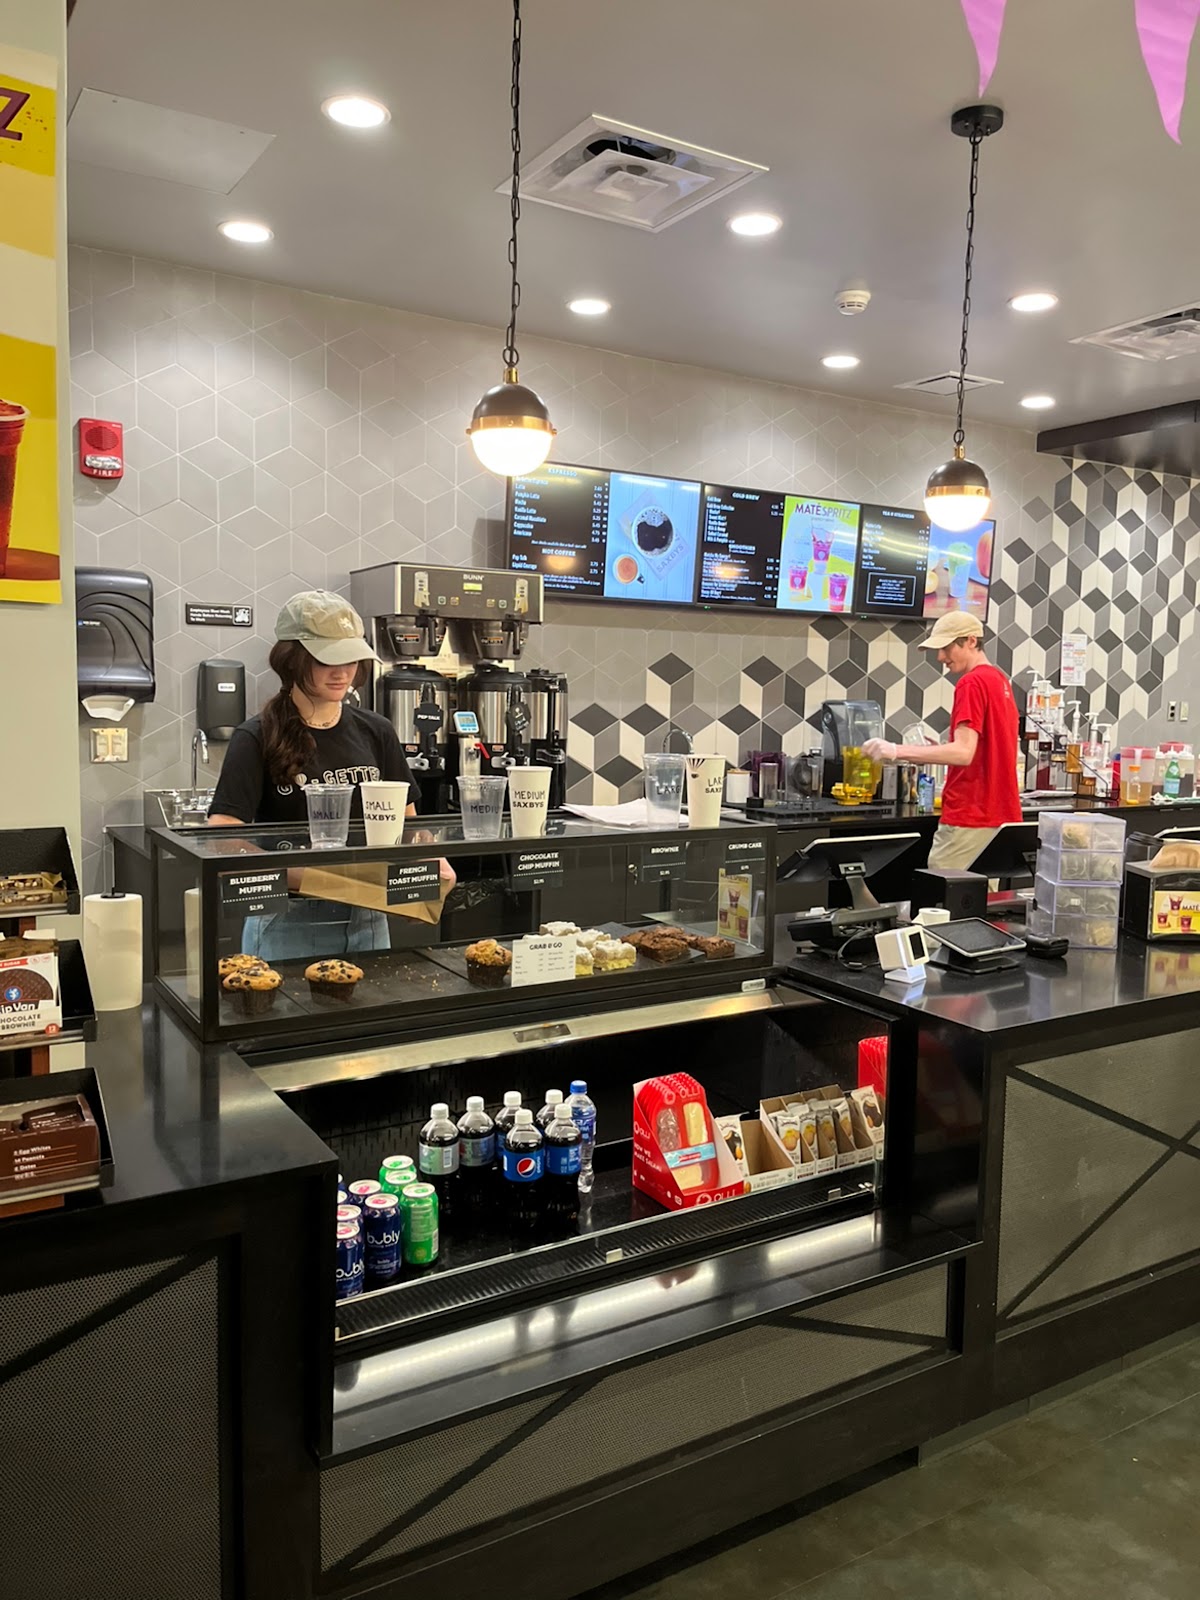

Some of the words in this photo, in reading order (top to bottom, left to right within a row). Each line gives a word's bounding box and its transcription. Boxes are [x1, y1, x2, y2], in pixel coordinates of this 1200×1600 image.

[93, 469, 113, 477] FIRE
[548, 468, 577, 477] ESPRESSO
[745, 493, 760, 501] BREW
[554, 549, 576, 557] COFFEE
[656, 543, 684, 573] SAXBYS
[708, 776, 723, 788] LAR
[514, 790, 546, 800] MEDIUM
[656, 784, 681, 796] LARG
[366, 801, 394, 811] SMALL
[470, 804, 500, 815] MEDIU
[512, 800, 544, 810] SAXBYS
[313, 810, 341, 820] SMALL
[651, 846, 680, 854] BROWNIE
[519, 852, 560, 862] CHOCOLATE
[399, 865, 428, 876] FRENCH
[518, 862, 534, 872] CHIP
[534, 860, 560, 870] MUFFIN
[229, 873, 281, 886] BLUEBERRY
[388, 876, 410, 886] TOAST
[411, 874, 438, 884] MUFFIN
[238, 884, 273, 896] MUFFIN
[249, 904, 264, 912] $2.95
[0, 1014, 41, 1025] HOCOLATE
[2, 1020, 36, 1030] BROWNIE
[22, 1154, 45, 1162] Peanuts
[366, 1230, 402, 1245] bubly
